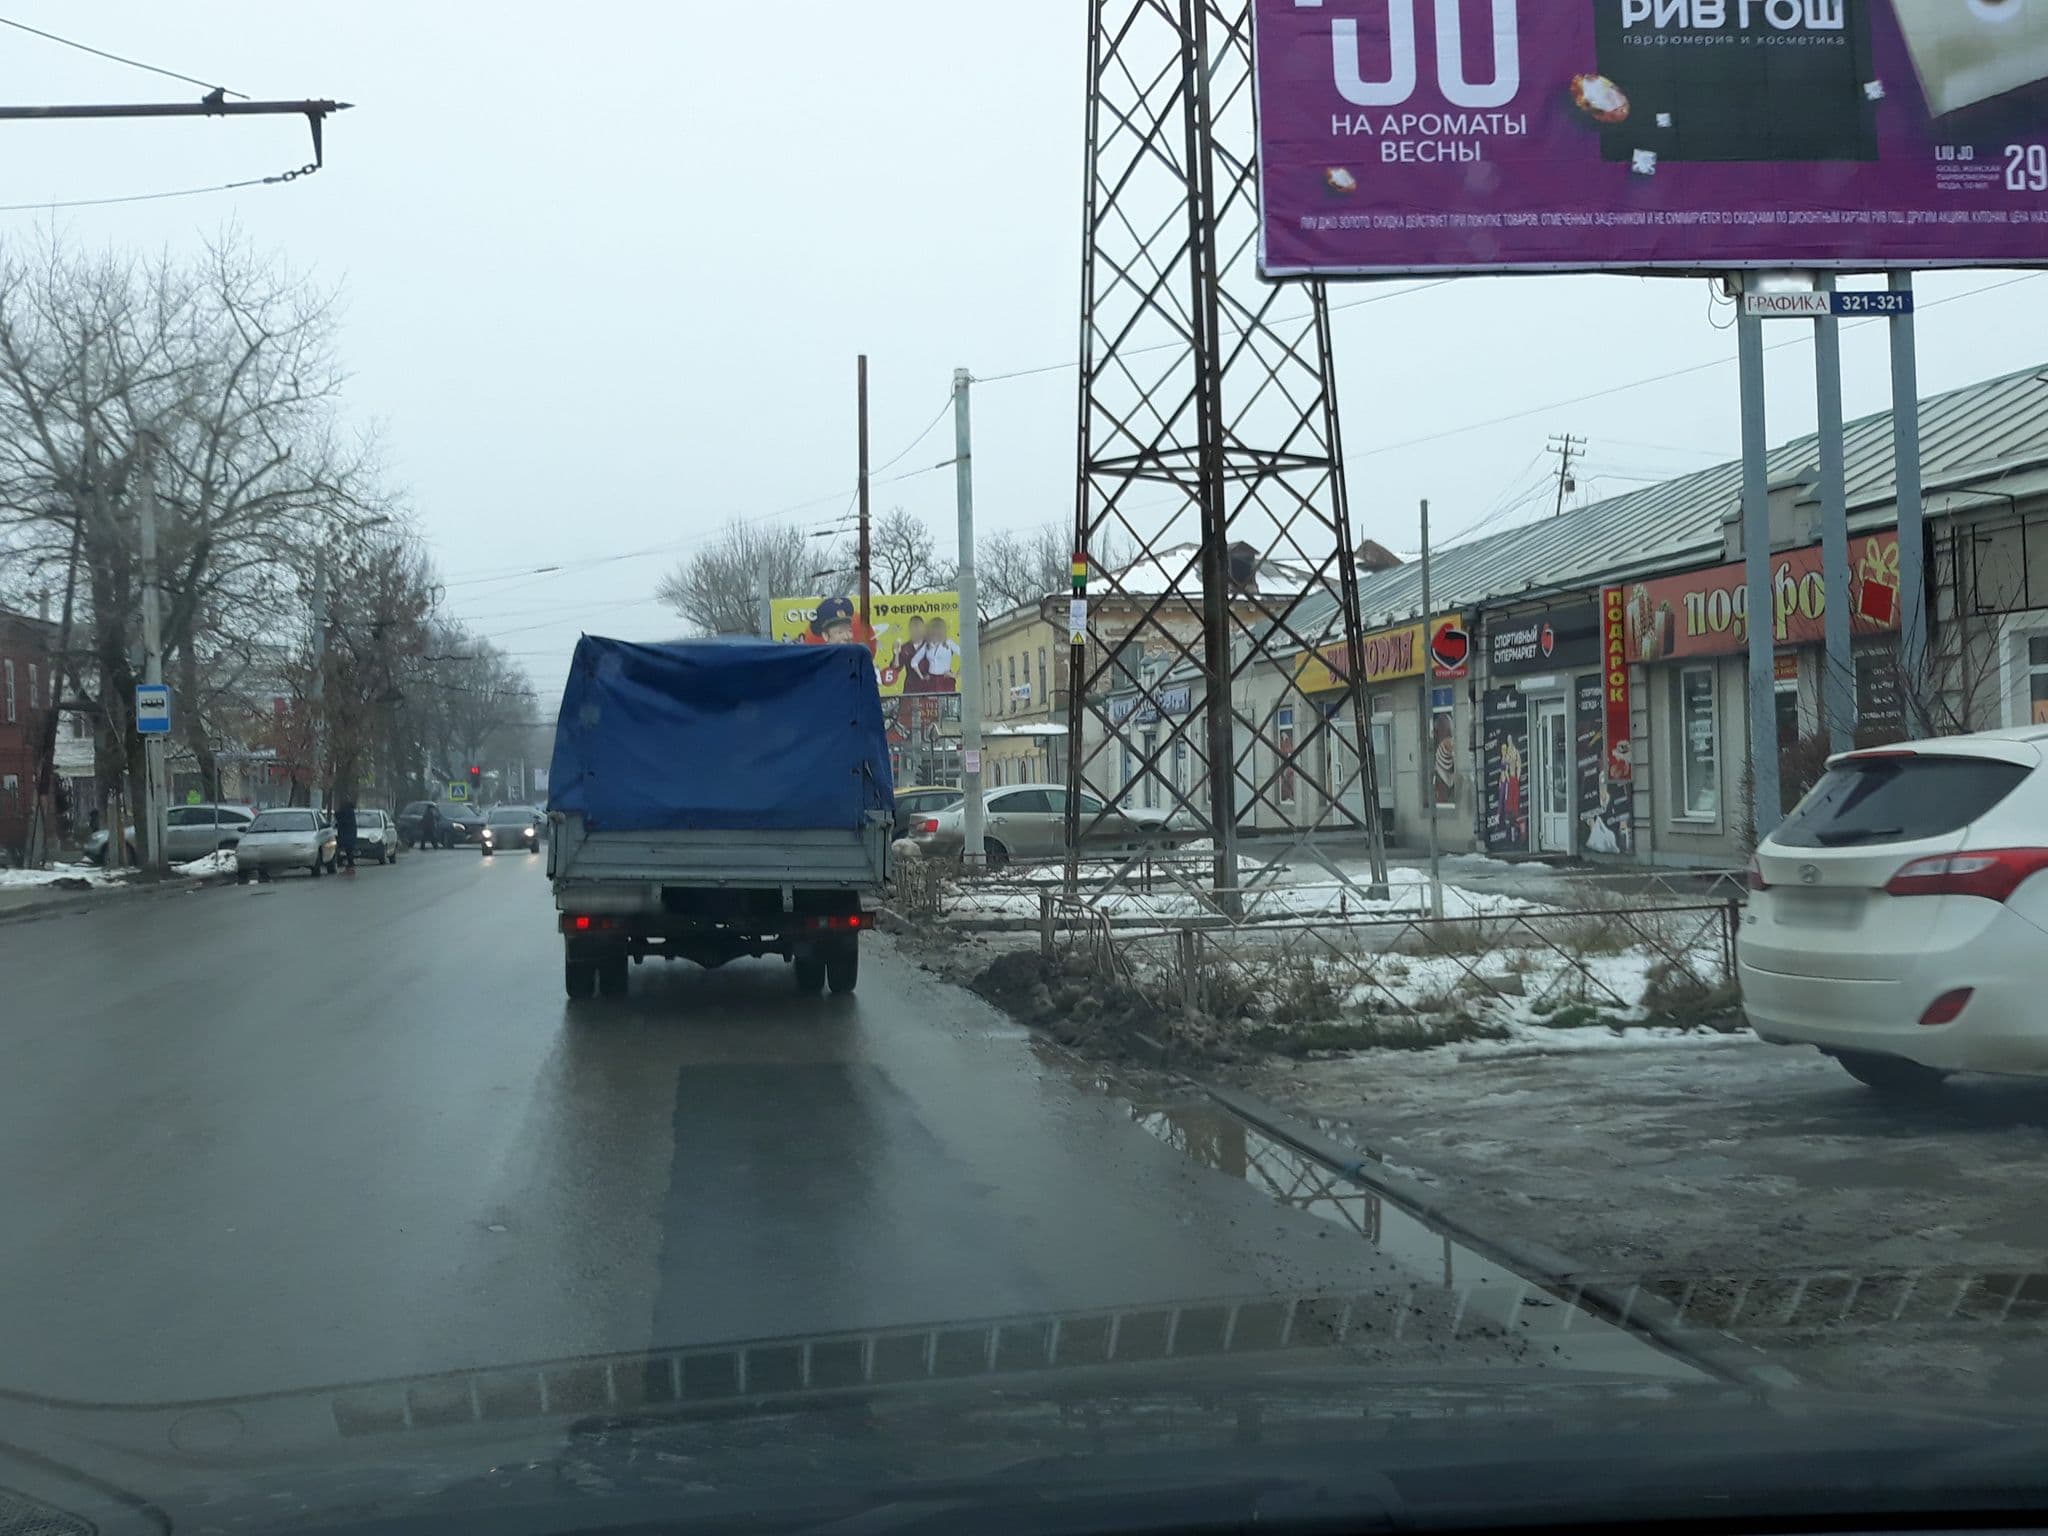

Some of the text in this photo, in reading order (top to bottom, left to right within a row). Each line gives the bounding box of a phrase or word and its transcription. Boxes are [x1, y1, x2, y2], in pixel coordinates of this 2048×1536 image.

[1622, 34, 1845, 46] парфюмерия и косметика
[1331, 113, 1527, 136] НА АРОМАТЫ
[1380, 140, 1481, 163] ВЕСНЫ
[1747, 295, 1903, 312] ГРАФИКА 321-321
[785, 608, 818, 622] СТС
[873, 603, 889, 617] 19
[890, 602, 941, 615] ФЕВРАЛЯ
[1494, 624, 1538, 649] СПОРТИВНЫЙ
[1607, 590, 1625, 703] ПОДАРОК
[1494, 644, 1538, 664] СУПЕРМАРКЕТ
